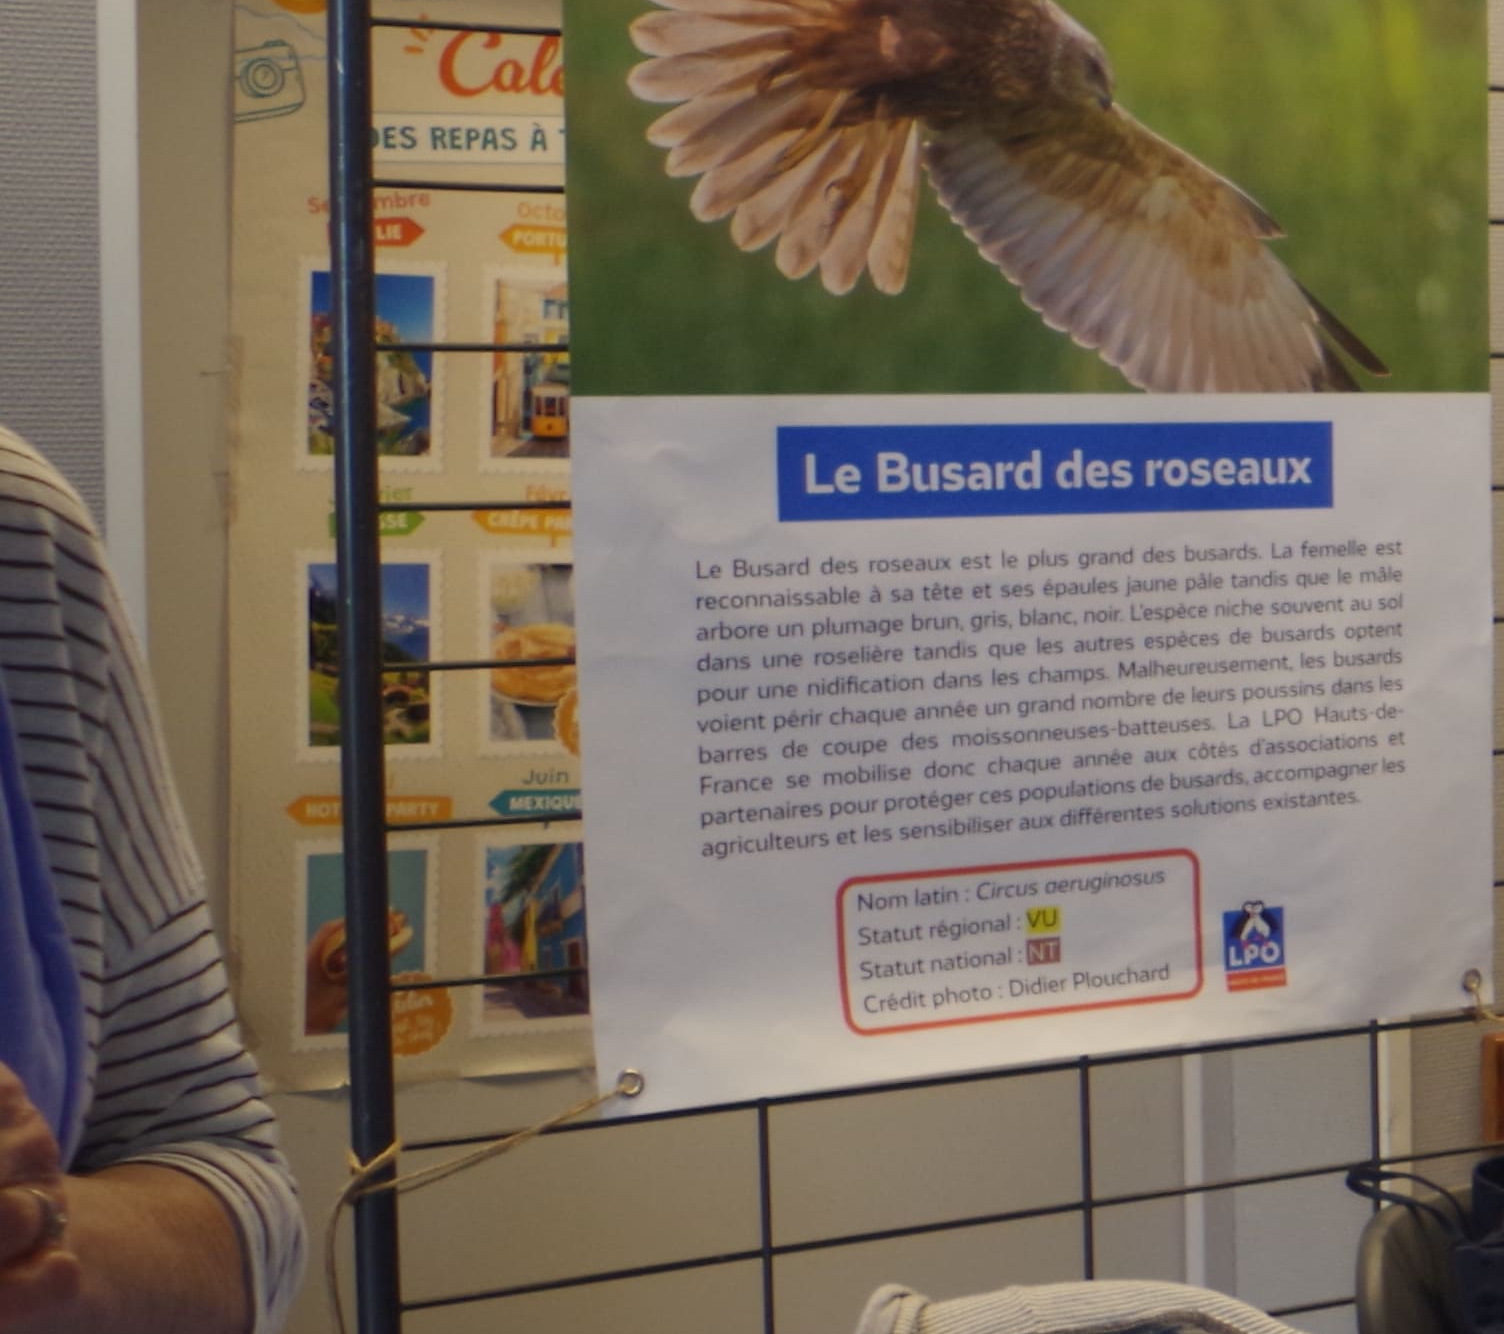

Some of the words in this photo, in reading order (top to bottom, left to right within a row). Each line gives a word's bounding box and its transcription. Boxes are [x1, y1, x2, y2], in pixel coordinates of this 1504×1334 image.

[430, 126, 518, 152] REPAS
[530, 122, 548, 152] À
[805, 453, 863, 495] Le
[876, 449, 1042, 494] Busard
[1054, 448, 1133, 491] des
[1145, 455, 1313, 490] roseaux
[694, 558, 723, 581] Le
[730, 554, 811, 579] Busard
[818, 554, 859, 576] des
[866, 556, 952, 574] roseaux
[958, 551, 992, 571] est
[999, 548, 1020, 570] le
[1026, 547, 1071, 572] plus
[1076, 545, 1136, 571] grand
[1140, 544, 1177, 564] des
[1269, 541, 1295, 561] La
[1298, 537, 1368, 560] femelle
[1373, 539, 1403, 557] est
[694, 584, 862, 611] reconnaissable
[867, 583, 883, 604] à
[888, 586, 915, 604] sa
[920, 580, 964, 603] tête
[970, 581, 993, 600] et
[998, 582, 1036, 599] ses
[1040, 575, 1120, 600] épaules
[1123, 574, 1179, 598] jaune
[1183, 570, 1225, 595] pâle
[1228, 568, 1289, 590] tandis
[1294, 570, 1331, 590] que
[1335, 565, 1353, 585] le
[1358, 564, 1404, 584] mâle
[694, 619, 771, 642] arbore
[775, 620, 805, 638] un
[810, 615, 905, 641] plumage
[1212, 597, 1265, 618] niche
[1268, 595, 1345, 616] souvent
[1348, 597, 1373, 612] au
[1376, 591, 1404, 612] sol
[694, 650, 752, 673] dans
[760, 651, 804, 670] une
[812, 643, 905, 667] roselière
[910, 638, 979, 662] tandis
[986, 640, 1028, 662] que
[1034, 634, 1065, 656] les
[1072, 634, 1136, 654] autres
[1142, 628, 1221, 652] espèces
[1227, 625, 1254, 646] de
[1259, 621, 1337, 644] busards
[1342, 620, 1404, 643] optent
[695, 684, 750, 708] pour
[755, 681, 799, 700] une
[805, 673, 926, 697] nidification
[931, 669, 984, 691] dans
[990, 666, 1021, 687] les
[1298, 650, 1327, 670] les
[1331, 646, 1404, 668] busards
[696, 743, 769, 766] barres
[780, 737, 809, 760] de
[820, 737, 889, 758] coupe
[899, 730, 939, 752] des
[1226, 710, 1251, 730] La
[1260, 706, 1304, 728] LPO
[521, 768, 570, 786] Juin
[698, 799, 824, 831] partenaires
[827, 796, 880, 820] pour
[882, 788, 975, 816] protéger
[977, 787, 1014, 806] ces
[1016, 777, 1137, 806] populations
[1139, 772, 1166, 793] de
[1251, 761, 1379, 785] accompagner
[1380, 756, 1407, 774] les
[699, 830, 831, 862] agriculteurs
[834, 827, 858, 846] et
[862, 822, 894, 844] les
[897, 814, 1015, 842] sensibiliser
[1017, 813, 1055, 832] aux
[1058, 804, 1166, 828] différentes
[1169, 796, 1258, 819] solutions
[857, 893, 909, 912] Nom
[914, 887, 959, 907] latin
[976, 880, 1039, 902] Circus
[1045, 869, 1167, 896] aeruginosus
[858, 923, 923, 947] Statut
[928, 913, 1012, 942] régional
[1026, 909, 1059, 930] VU
[860, 957, 926, 981] Statut
[930, 947, 1013, 973] national
[1028, 941, 1060, 962] NT
[1229, 941, 1281, 967] LPO
[863, 988, 927, 1014] Crédit
[932, 984, 993, 1010] photo
[1008, 975, 1067, 999] Didier
[1072, 963, 1171, 991] Plouchard
